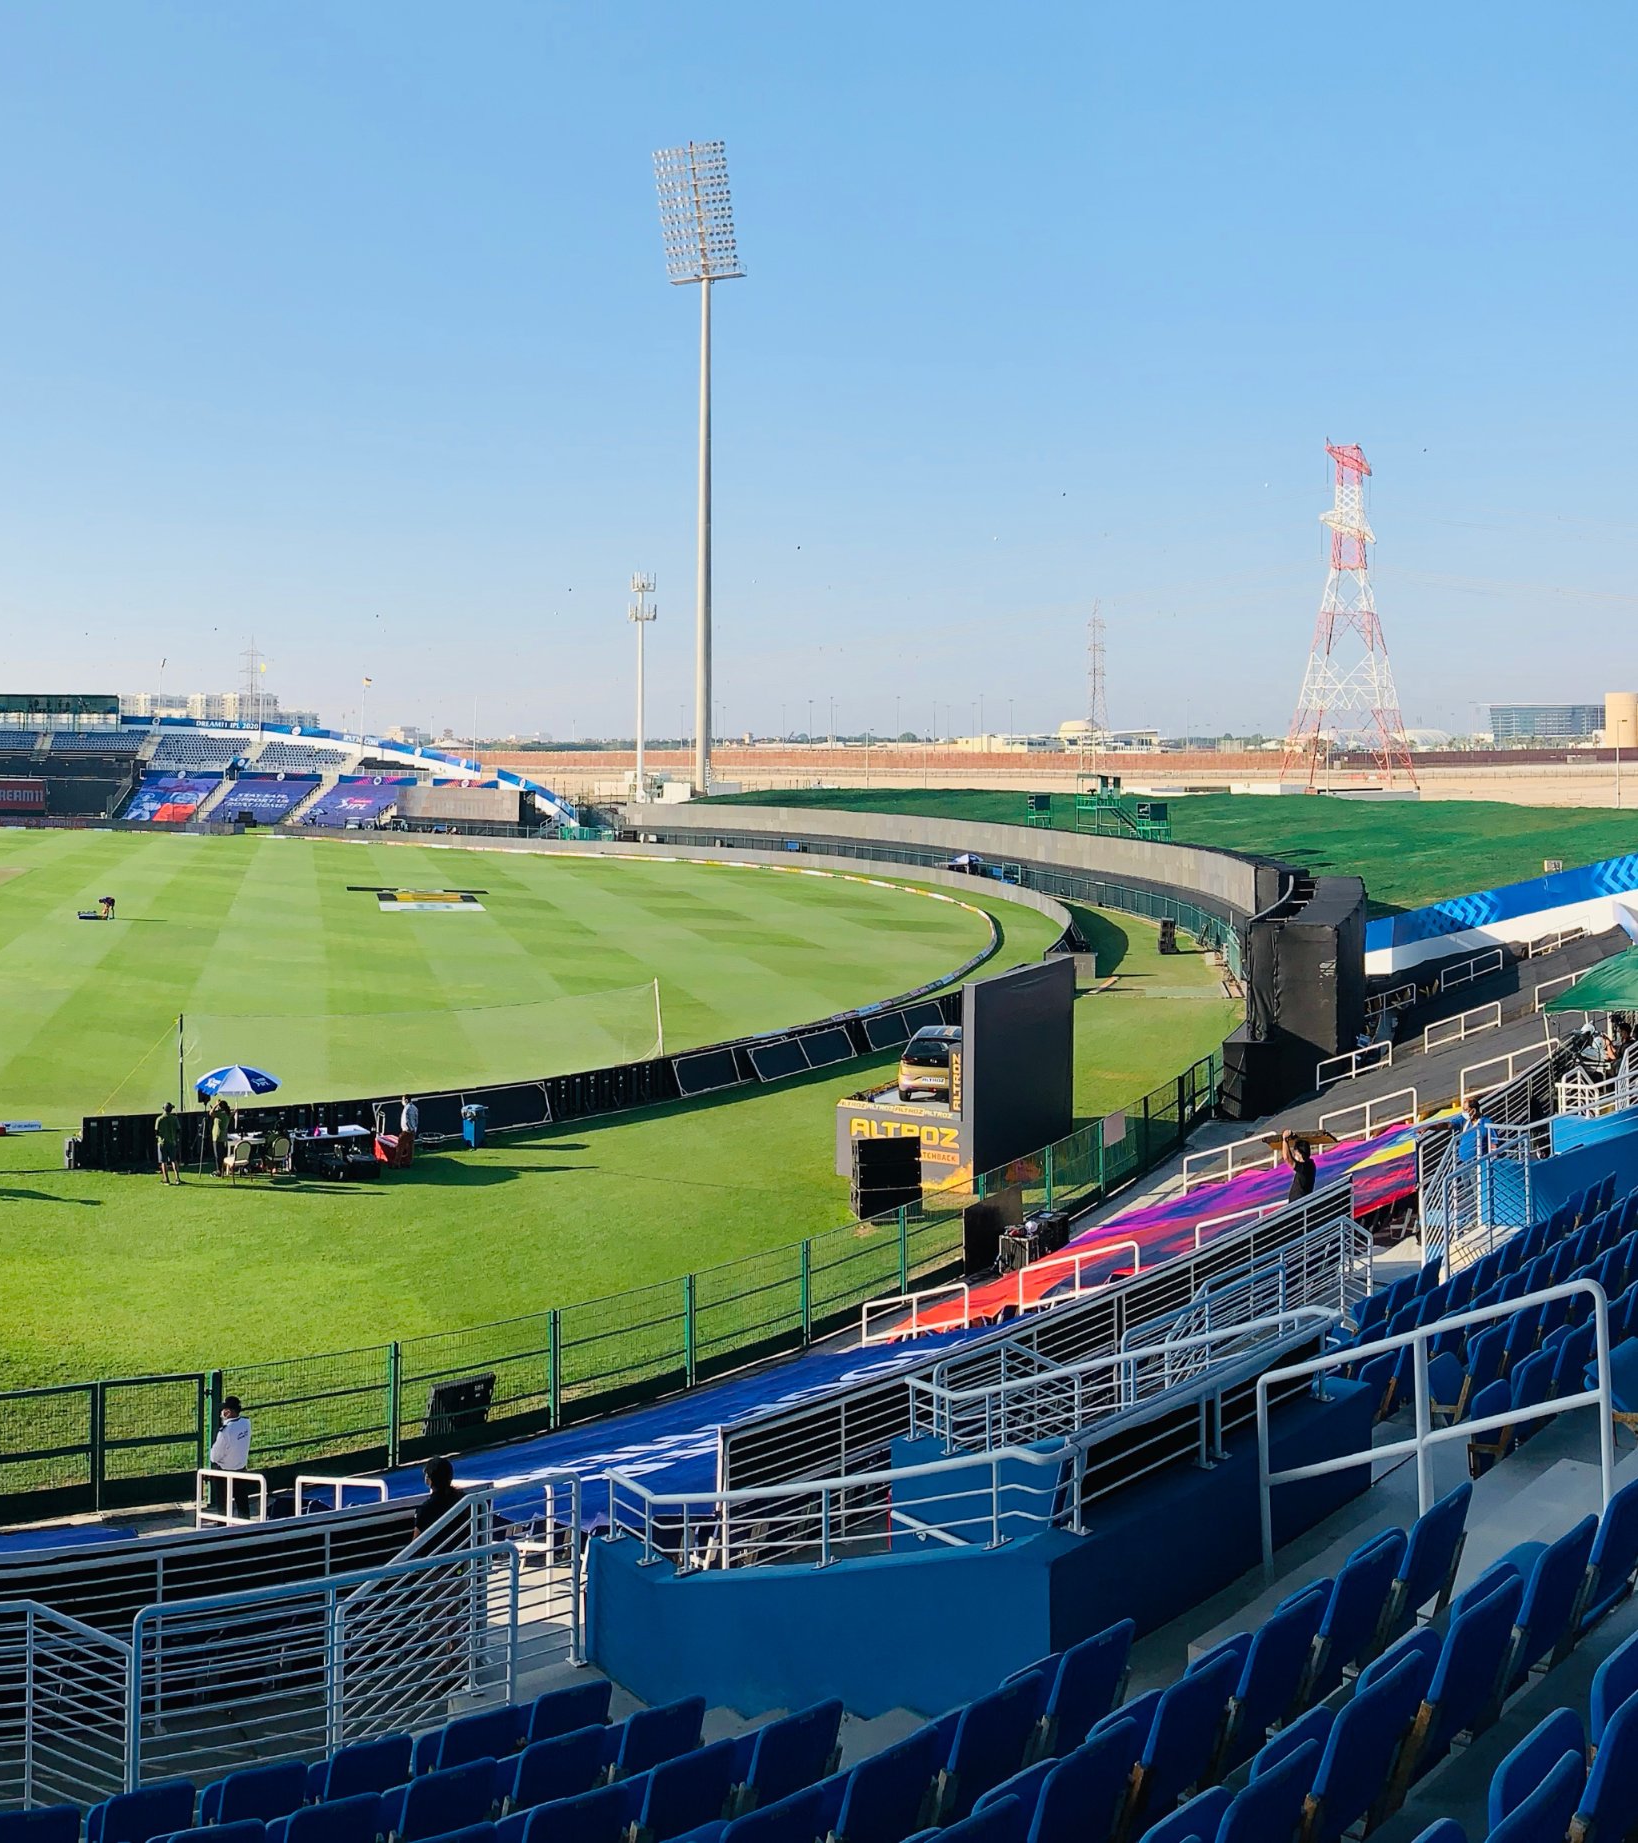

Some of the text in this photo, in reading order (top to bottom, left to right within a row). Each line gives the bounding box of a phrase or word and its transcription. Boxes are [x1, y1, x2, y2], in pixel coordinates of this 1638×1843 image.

[196, 720, 227, 728] DREAM11
[242, 722, 259, 730] 2020
[953, 1053, 962, 1112] ALTROZ
[895, 1107, 924, 1115] ALTROZ
[850, 1117, 960, 1150] ALTROZ
[922, 1152, 956, 1162] TCHBACK
